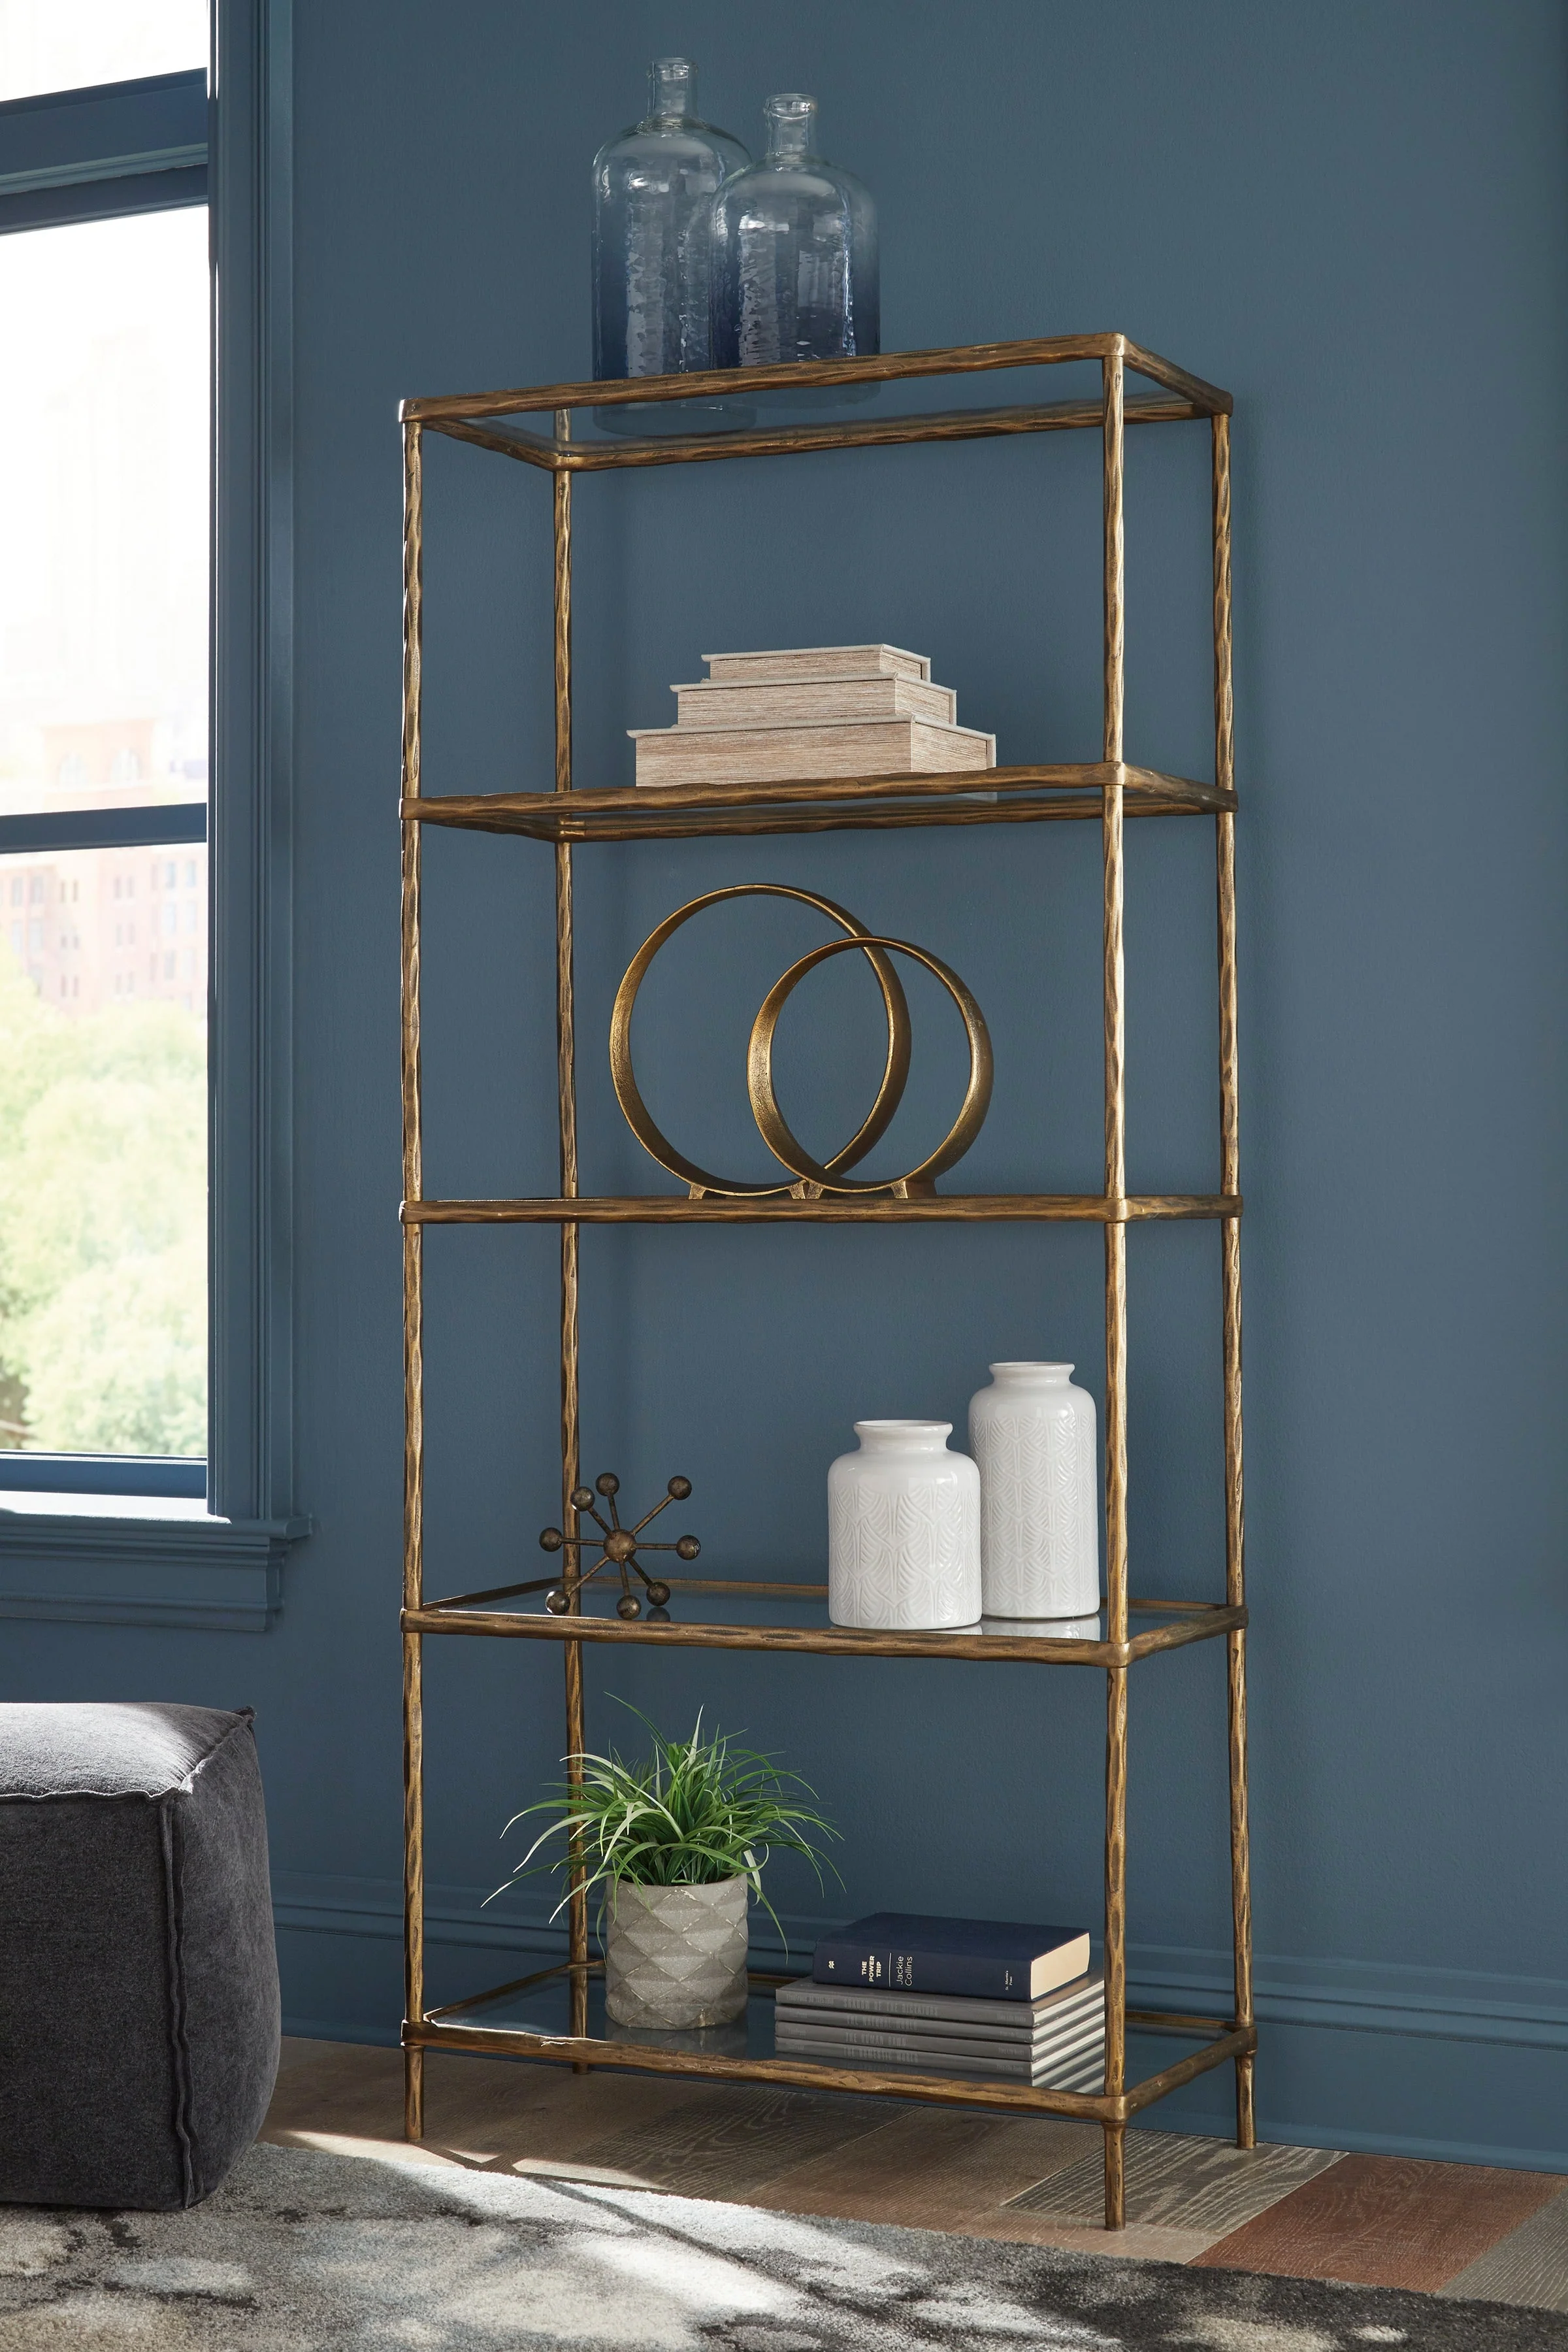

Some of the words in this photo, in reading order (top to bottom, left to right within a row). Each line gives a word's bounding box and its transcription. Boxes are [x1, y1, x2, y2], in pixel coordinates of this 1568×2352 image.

[887, 2002, 898, 2013] THE
[845, 2032, 857, 2043] THE
[843, 2047, 855, 2057] THE
